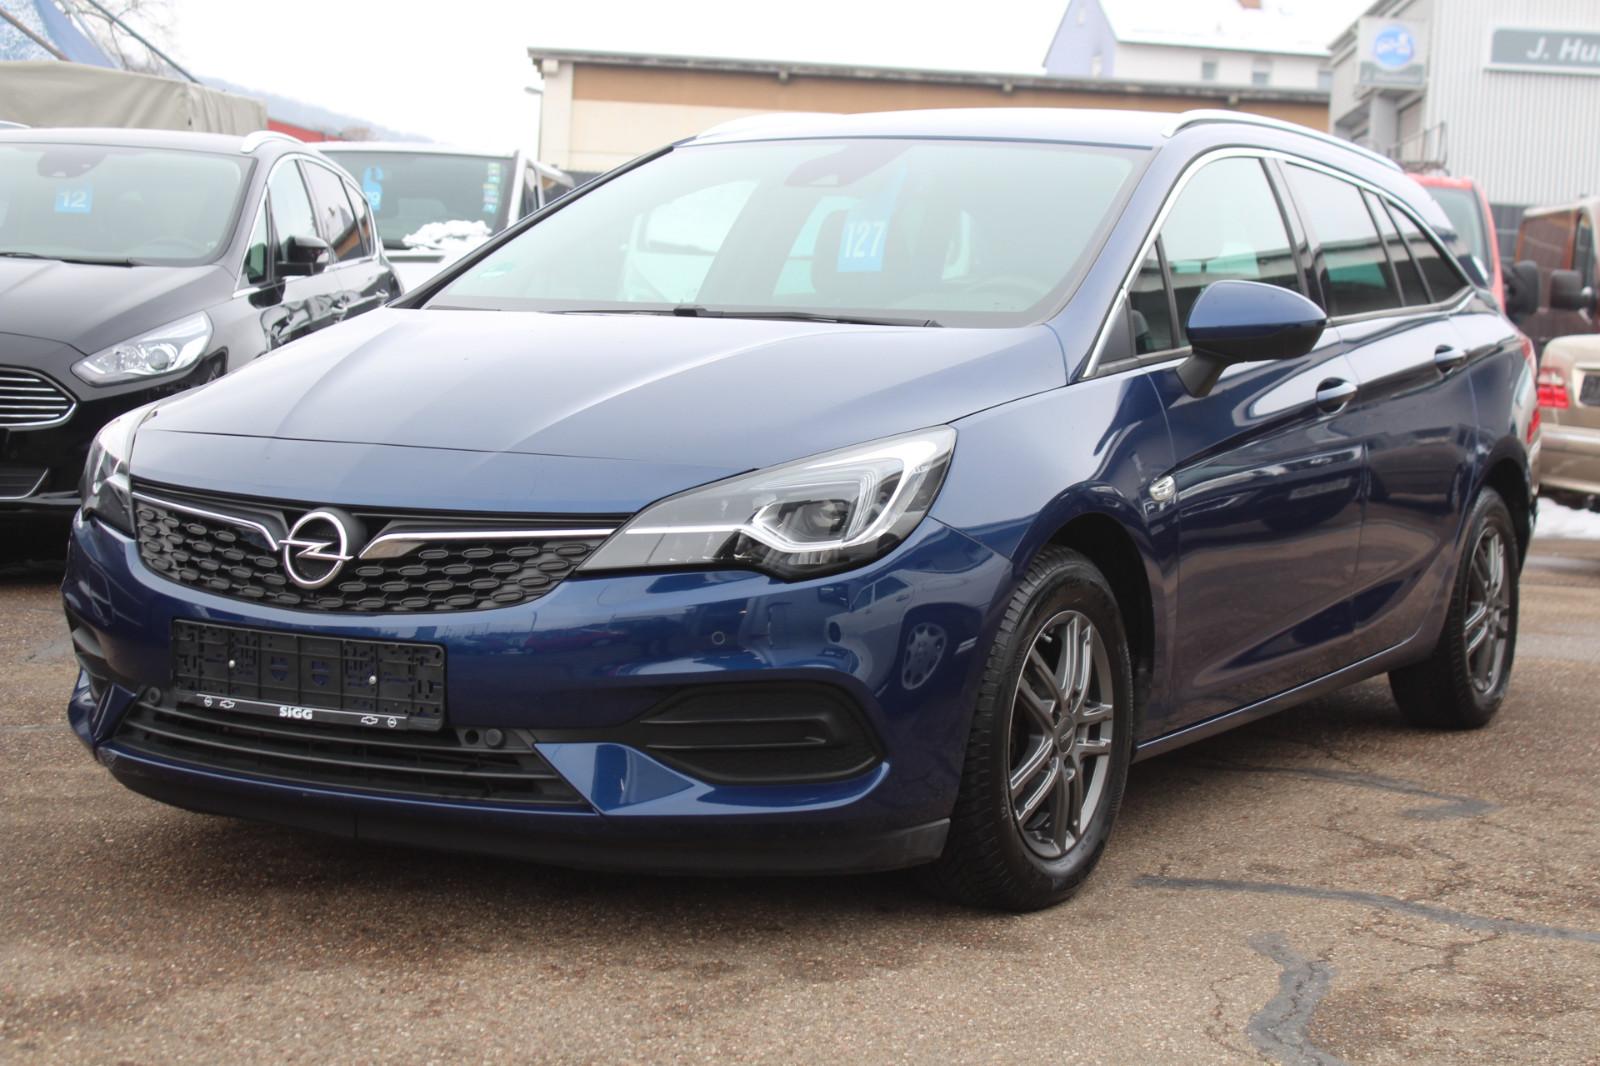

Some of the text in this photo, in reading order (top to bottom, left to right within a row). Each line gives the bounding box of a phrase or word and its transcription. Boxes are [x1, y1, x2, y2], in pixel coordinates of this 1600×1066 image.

[1526, 36, 1600, 62] J. Hu
[844, 222, 887, 258] 127
[279, 705, 313, 721] SIGG
